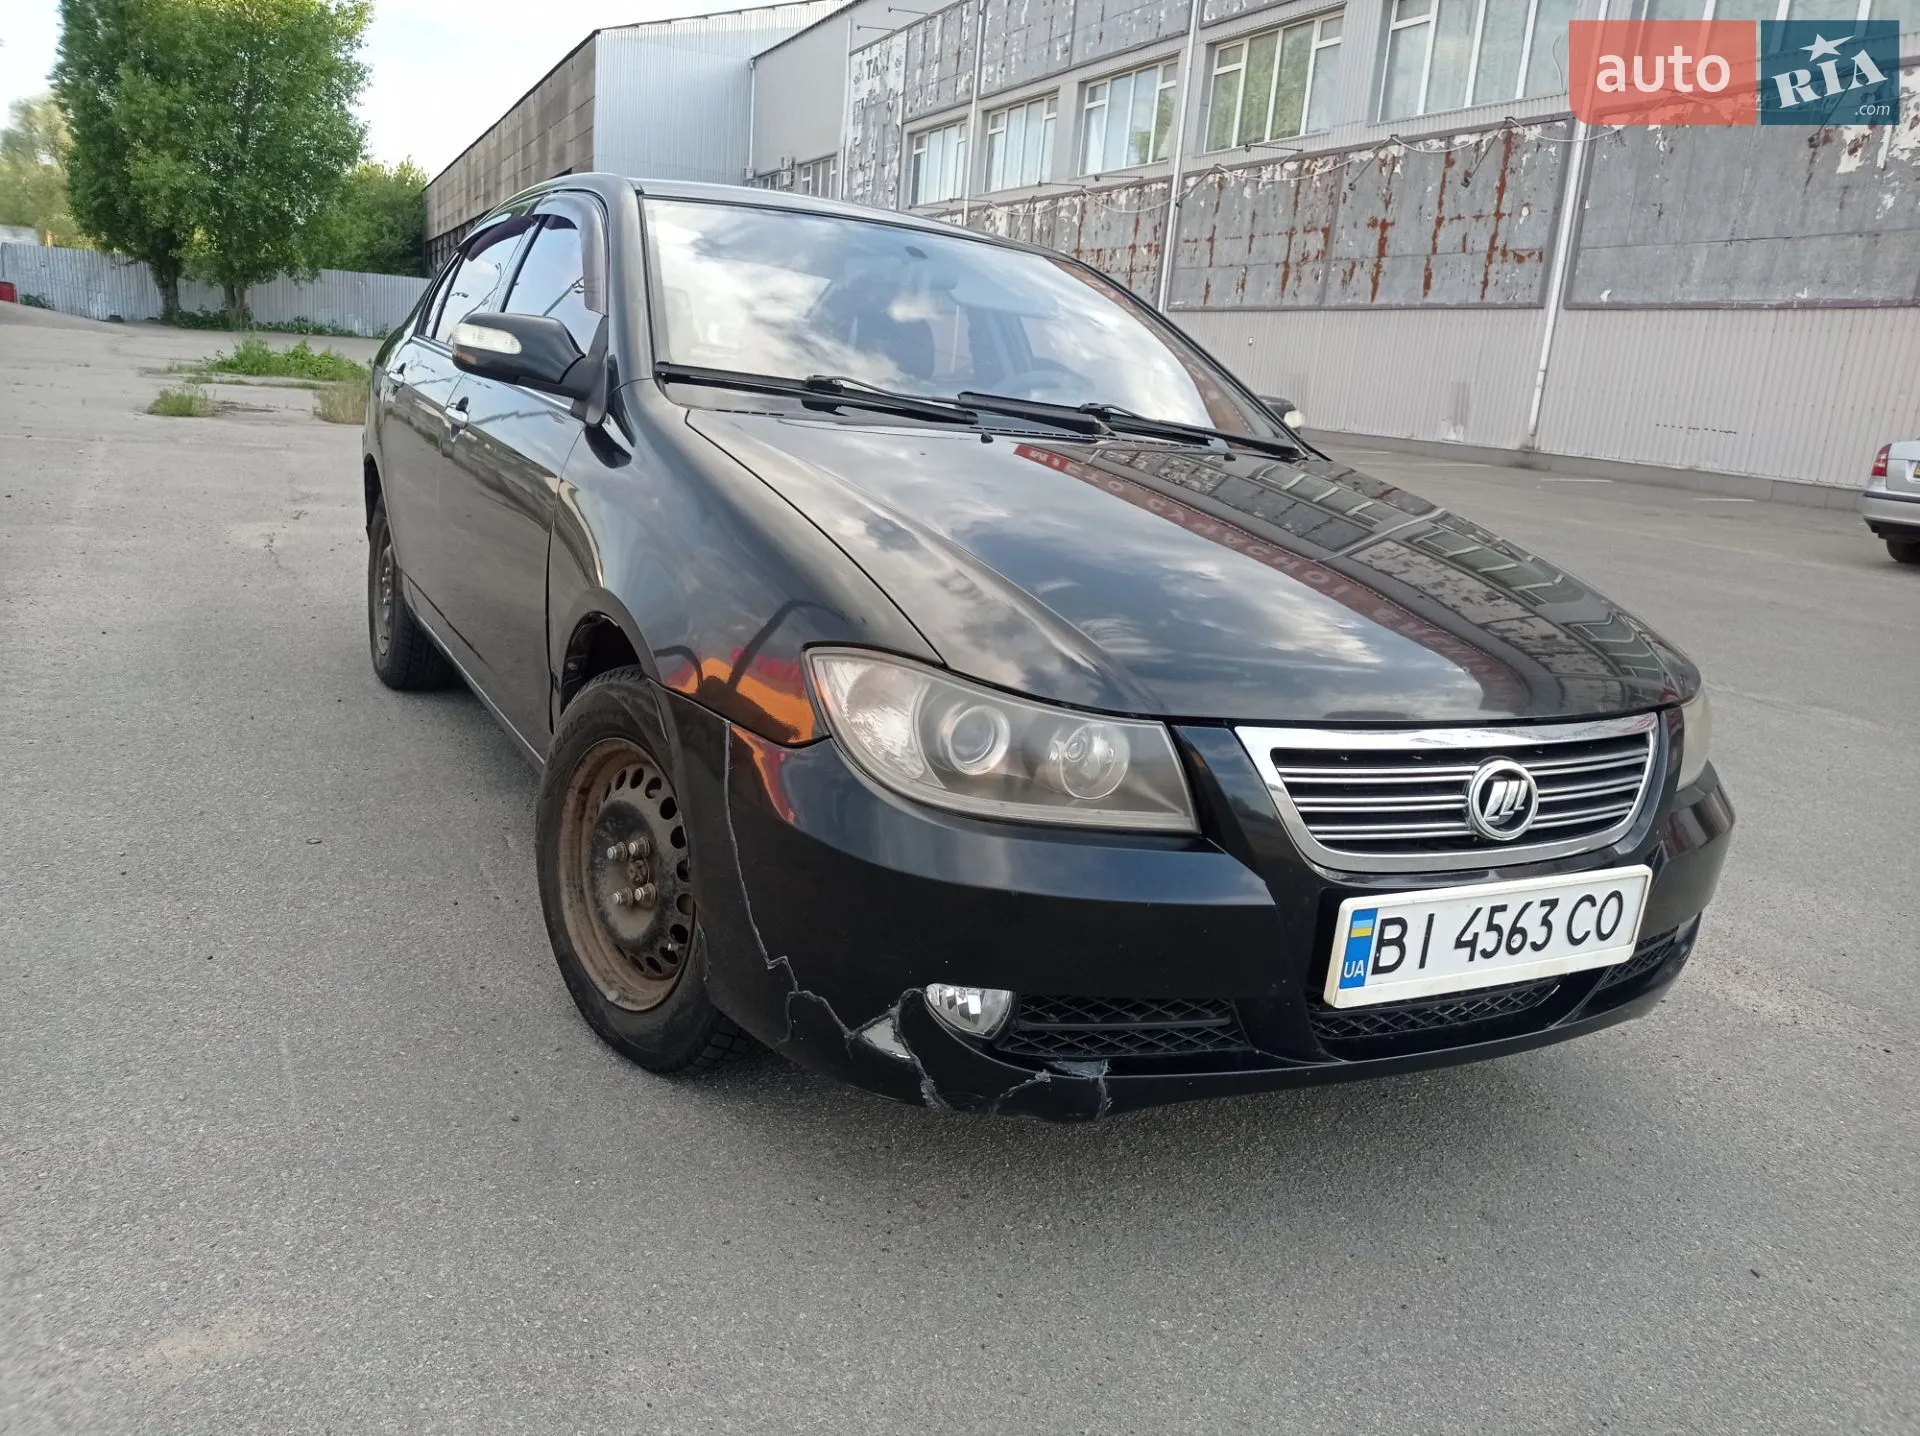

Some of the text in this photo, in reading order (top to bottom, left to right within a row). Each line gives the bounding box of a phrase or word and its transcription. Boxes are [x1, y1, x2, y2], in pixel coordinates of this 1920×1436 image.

[1371, 889, 1624, 975] BI 4563 CO
[1343, 961, 1365, 979] UA
